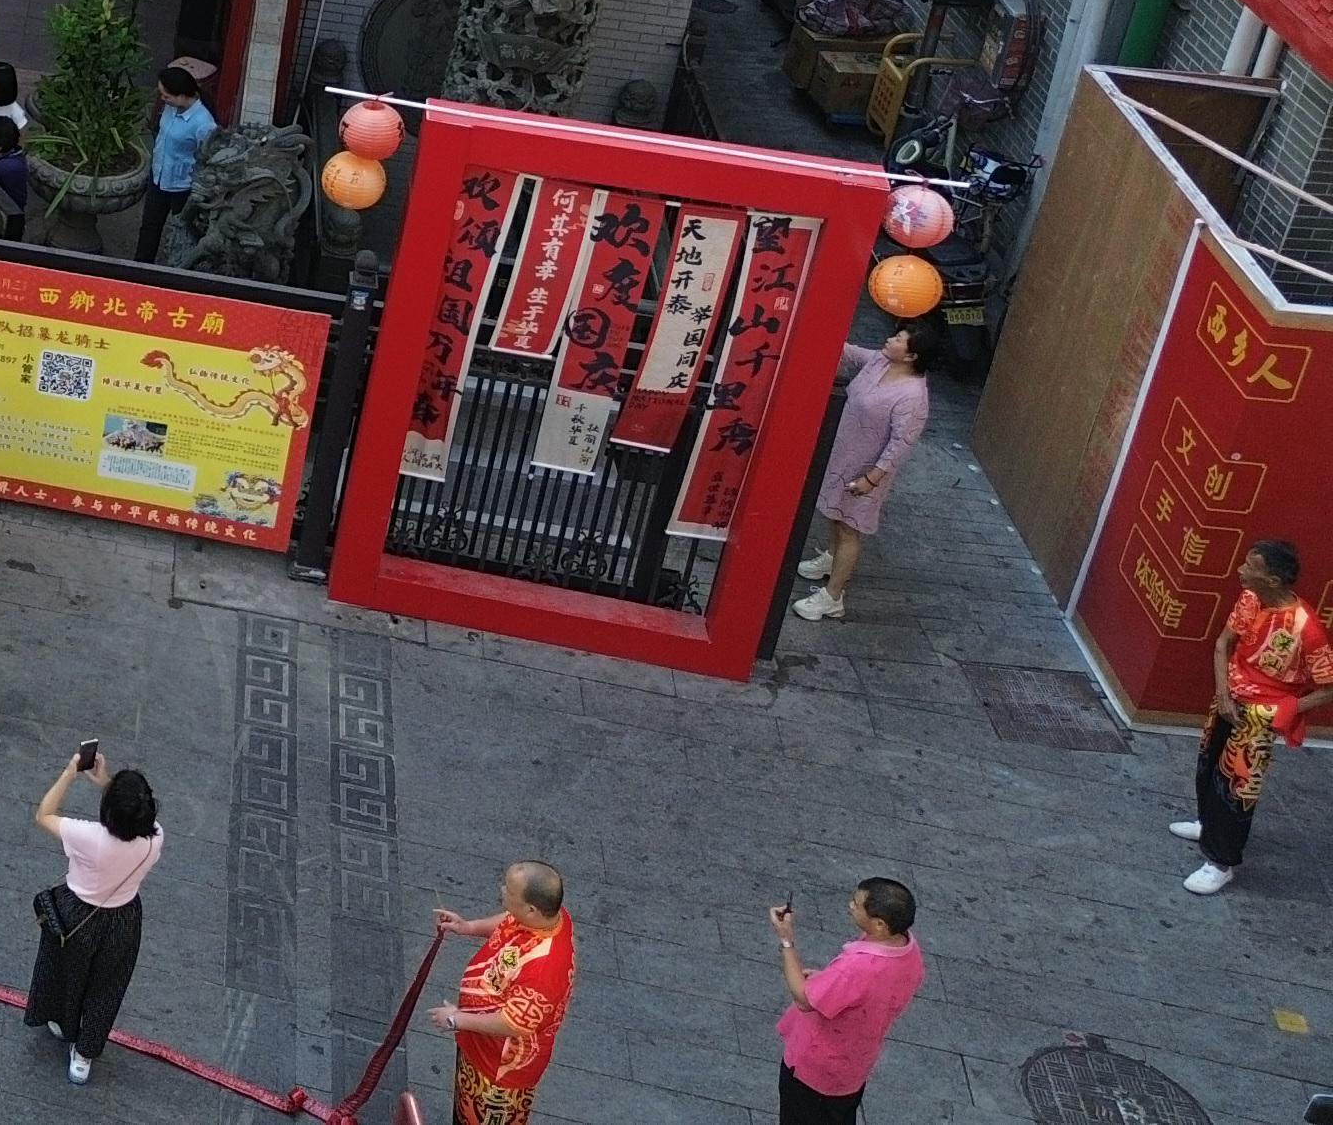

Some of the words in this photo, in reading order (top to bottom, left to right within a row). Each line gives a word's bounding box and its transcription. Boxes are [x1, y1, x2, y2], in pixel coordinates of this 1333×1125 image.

[535, 188, 579, 281] 何其有幸
[664, 218, 707, 316] 天地开泰
[20, 353, 35, 384] 小管家
[666, 305, 714, 390] 举国同庆
[1207, 304, 1293, 390] 西乡人
[1176, 426, 1233, 501] 文创
[1156, 488, 1211, 566] 手信
[1134, 552, 1188, 629] 体验馆
